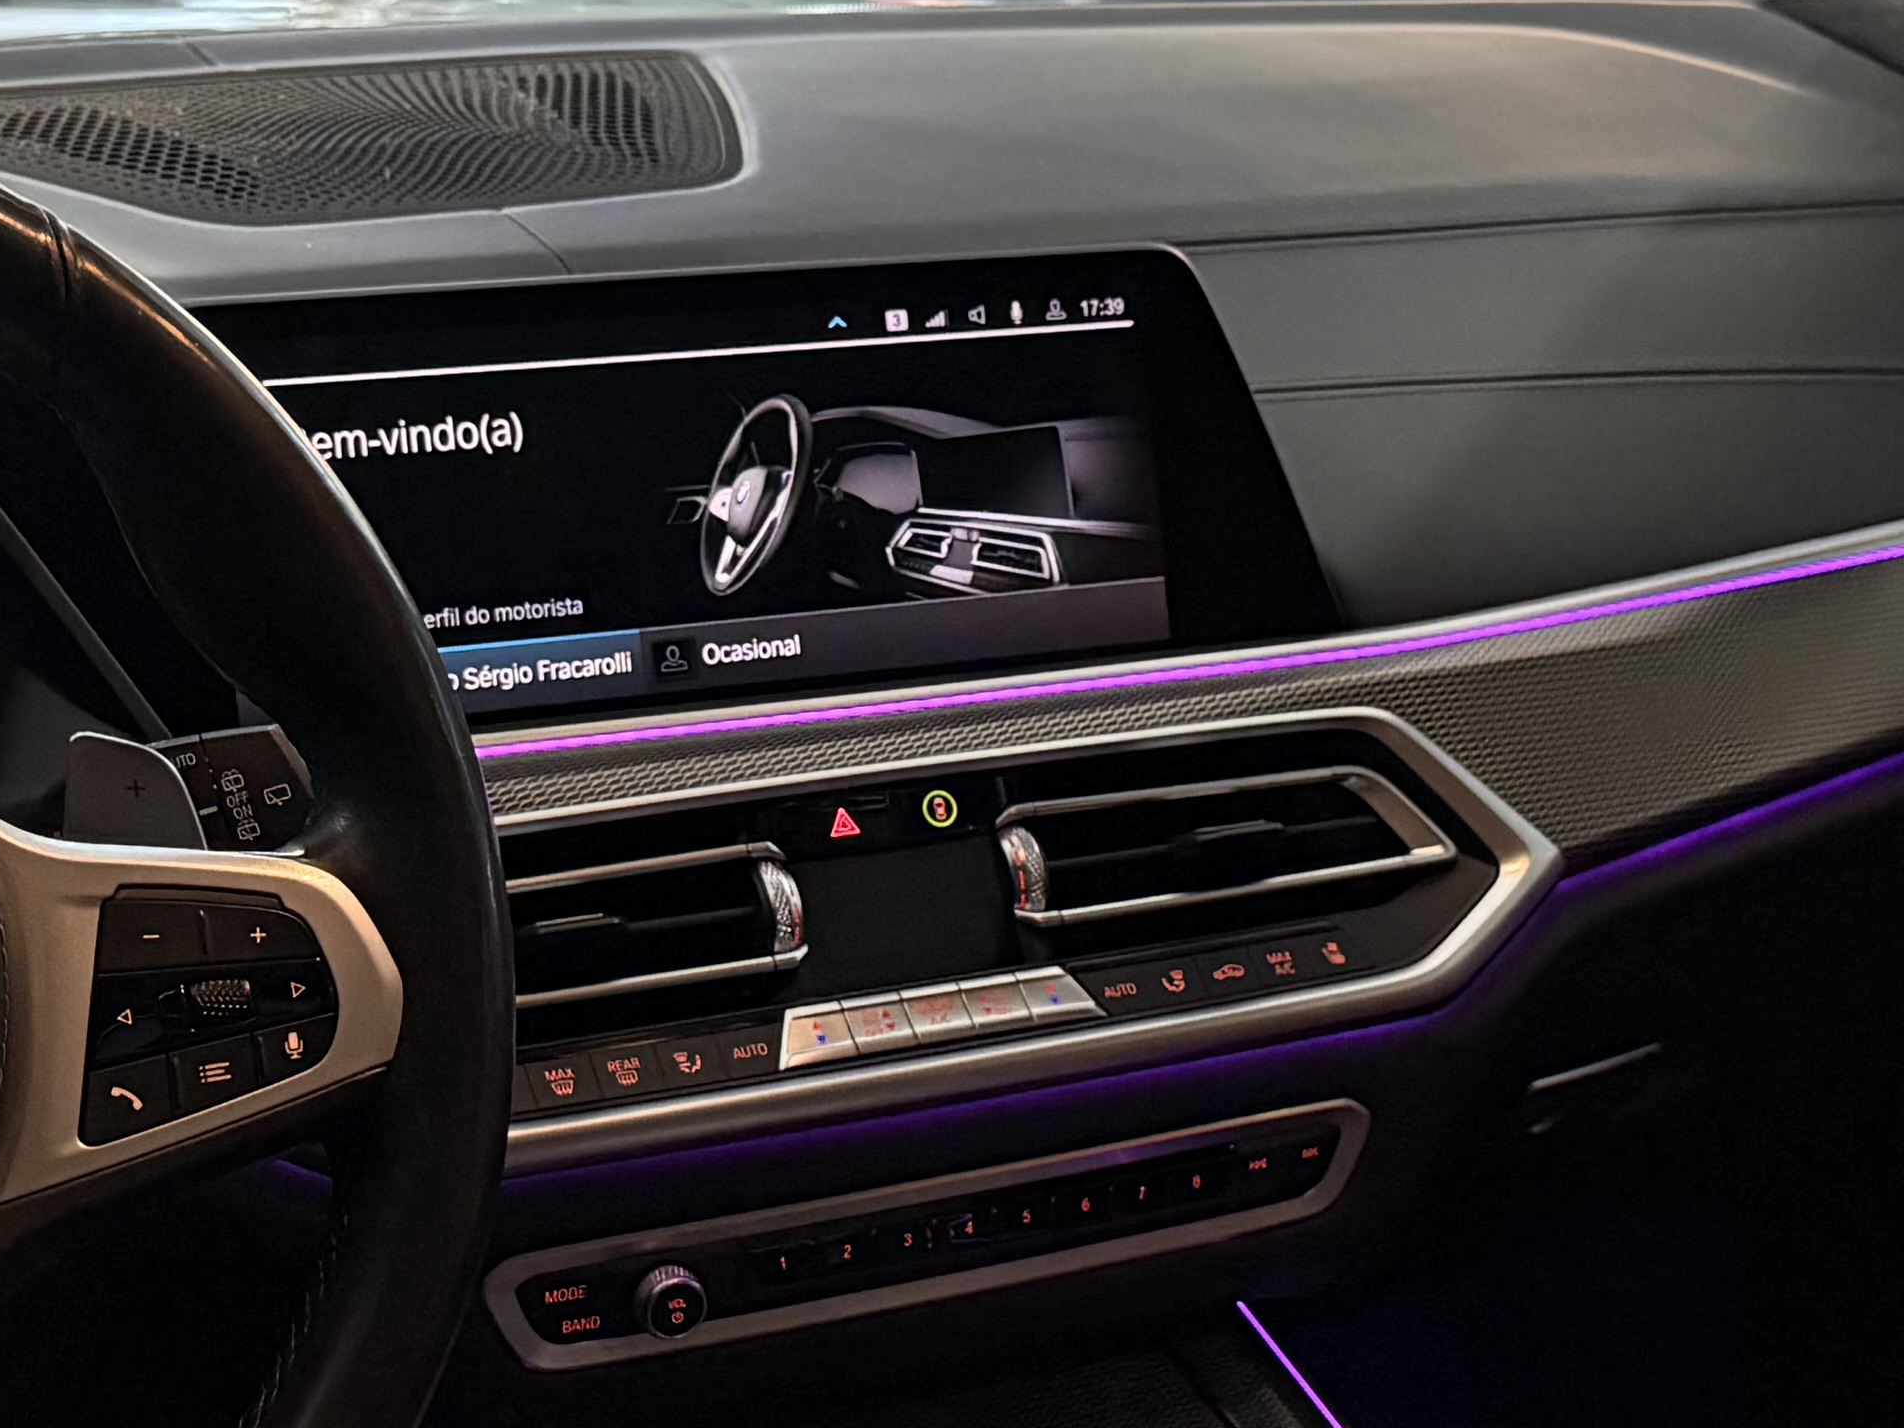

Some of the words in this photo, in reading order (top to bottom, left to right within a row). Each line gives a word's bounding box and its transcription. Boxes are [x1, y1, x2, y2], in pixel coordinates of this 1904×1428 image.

[1079, 297, 1126, 317] 17:39
[304, 410, 524, 461] em-vindo(a)
[424, 606, 460, 629] erfil
[465, 605, 490, 625] do
[496, 596, 584, 622] motorista
[701, 634, 801, 666] Ocasional
[462, 663, 533, 691] Sérgio
[536, 650, 633, 682] Fracarolli
[226, 790, 249, 808] OFF
[232, 803, 253, 820] ON
[1104, 982, 1137, 998] AUTO
[732, 1042, 769, 1060] AUTO
[607, 1057, 641, 1073] REAR
[544, 1068, 576, 1082] MAX
[1022, 1209, 1031, 1224] 5
[903, 1232, 913, 1247] 3
[843, 1244, 853, 1260] 2
[545, 1285, 587, 1304] MODE
[562, 1316, 601, 1334] BAND
